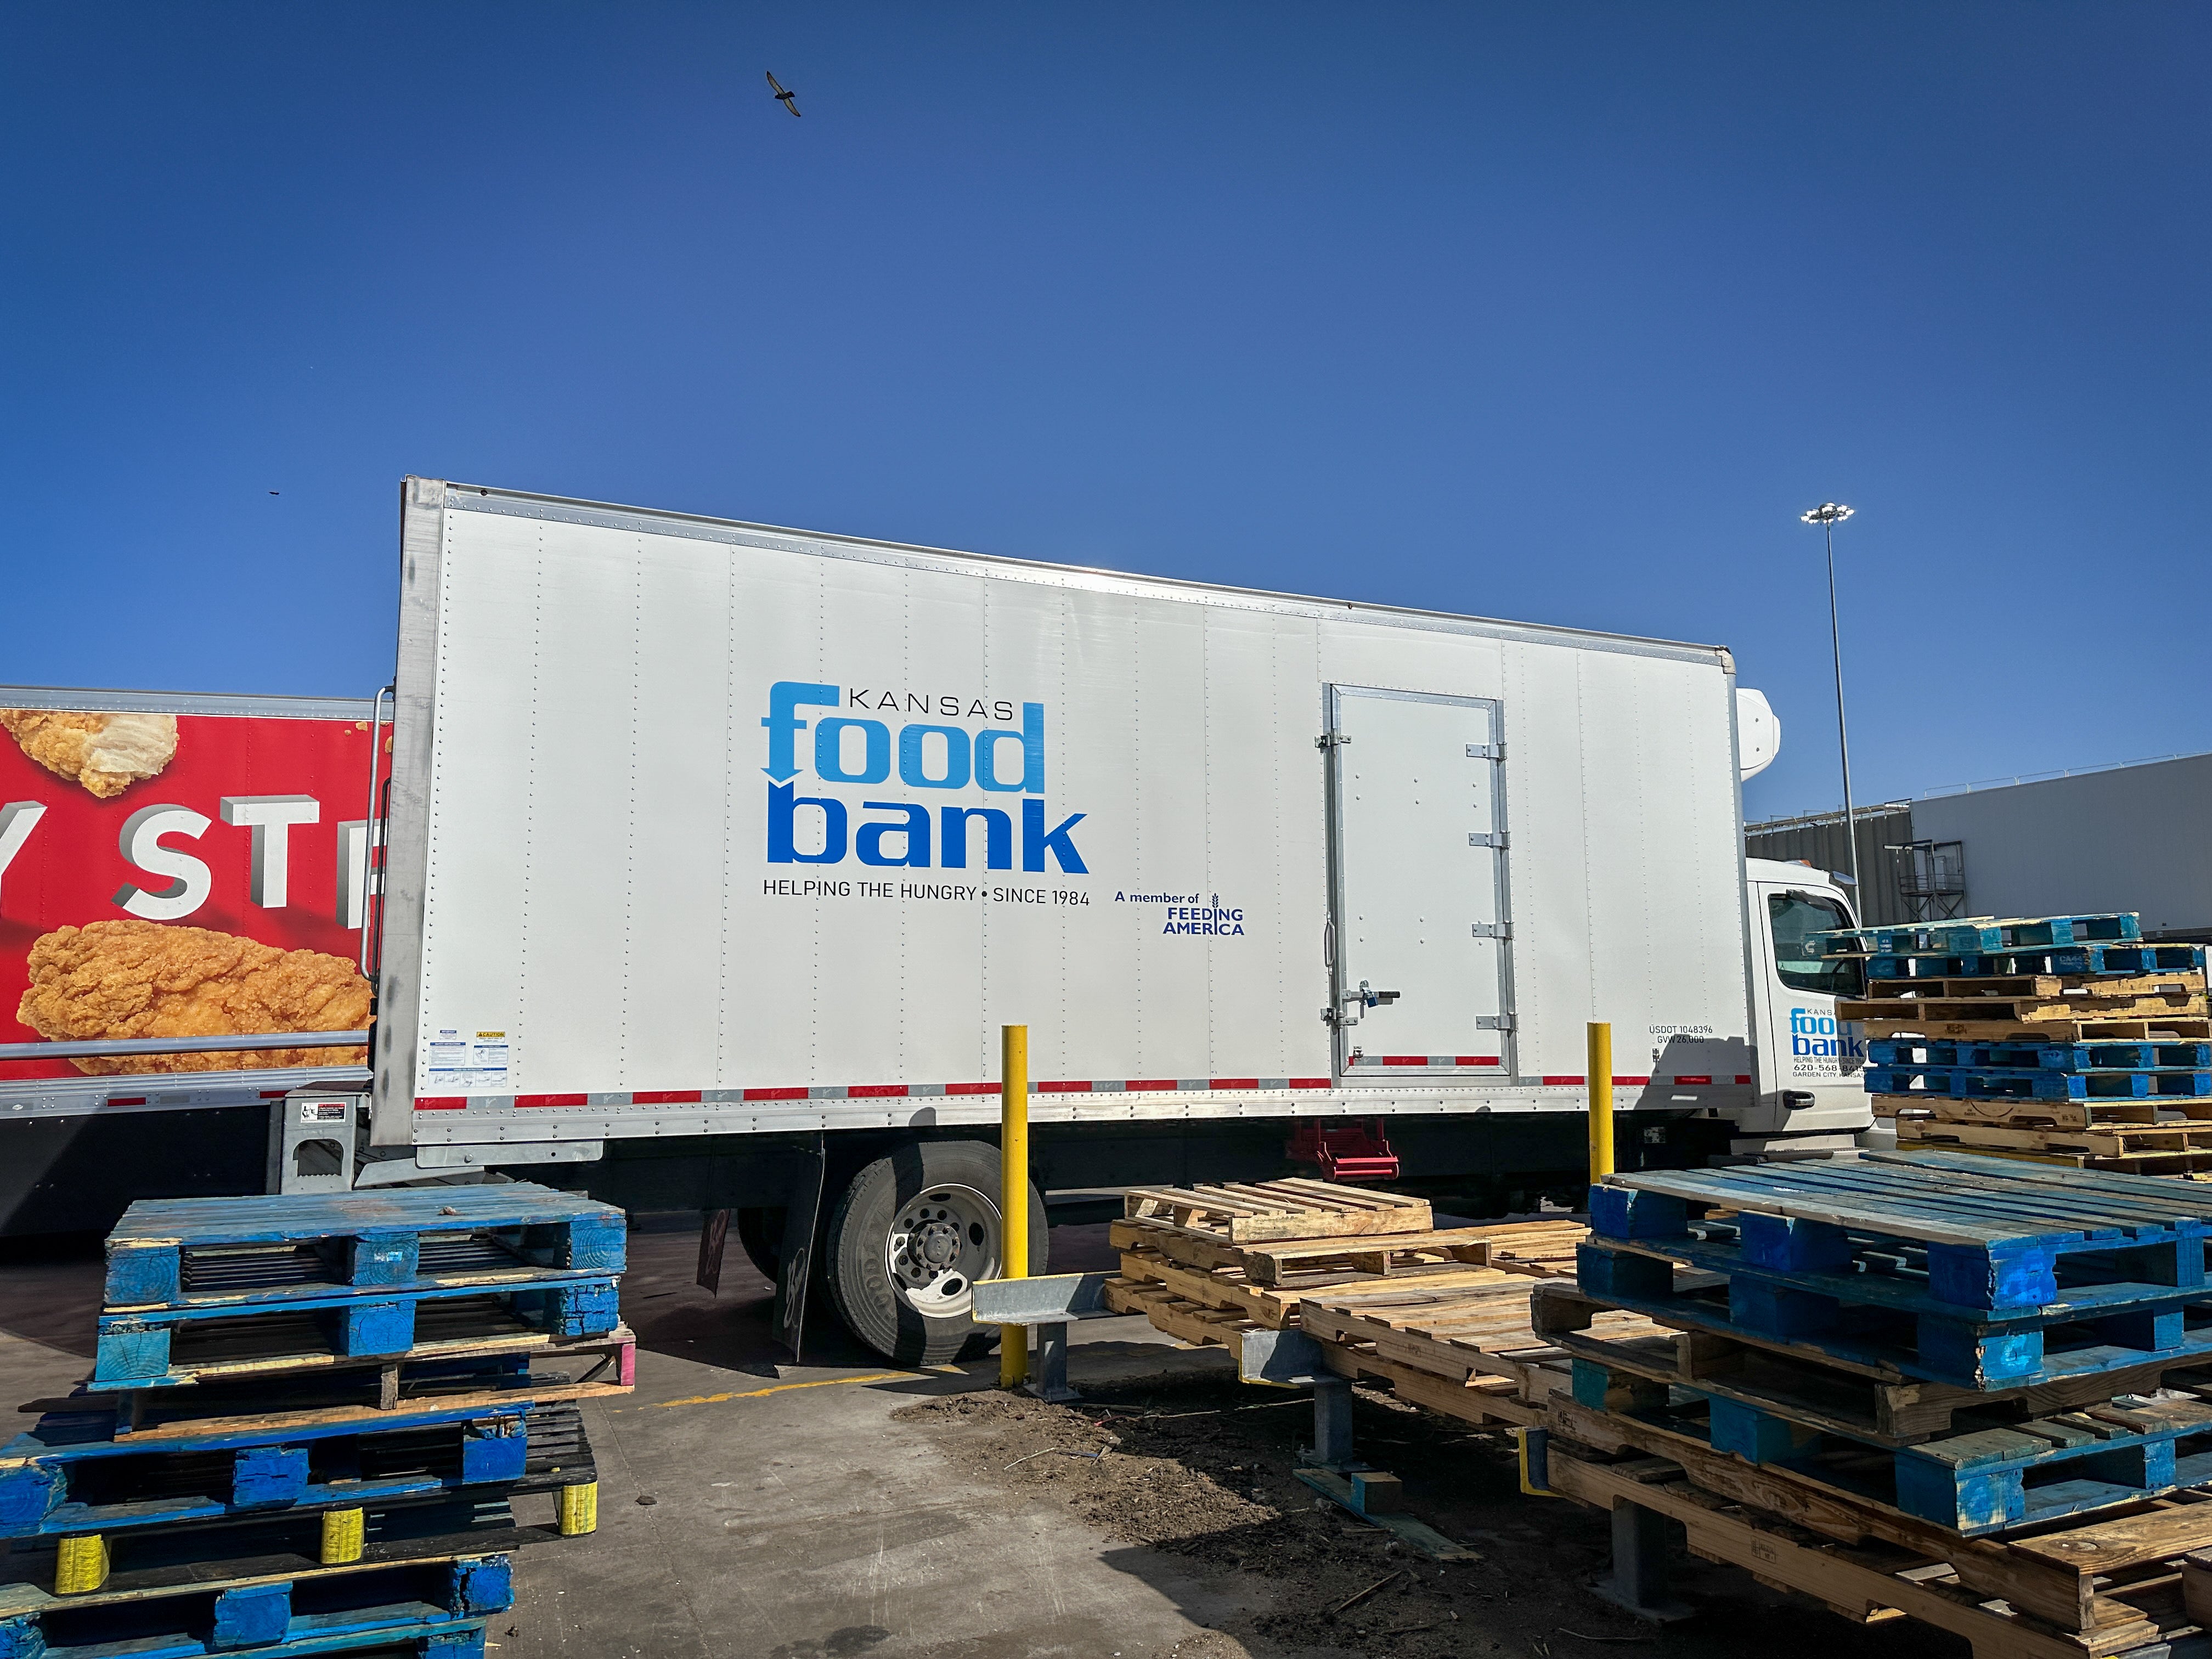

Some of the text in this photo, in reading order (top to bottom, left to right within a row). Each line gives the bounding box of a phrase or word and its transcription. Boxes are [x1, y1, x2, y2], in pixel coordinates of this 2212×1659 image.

[849, 687, 1013, 721] KANSAS
[760, 681, 1045, 794] food
[767, 780, 1090, 874] bank
[763, 879, 1090, 906] HELPING THE HUNGRY SINCE 1984
[1114, 891, 1200, 904] A member of
[1167, 907, 1243, 922] FEEDING
[1163, 922, 1245, 935] AMERICA
[1649, 1025, 1713, 1034] USDOT 1048396
[1657, 1035, 1705, 1045] GVW 26,000
[1792, 1034, 1864, 1057] bank
